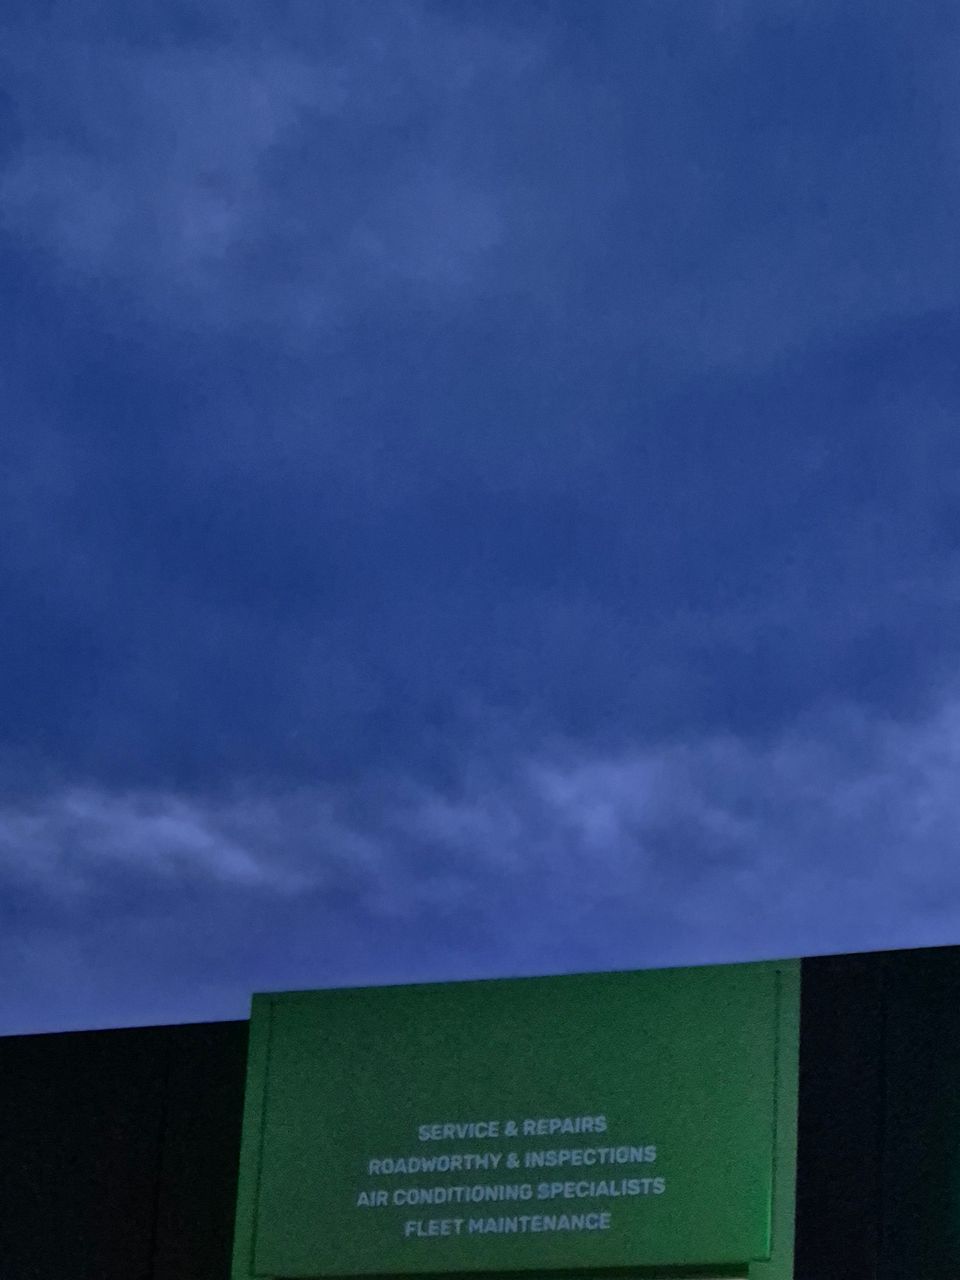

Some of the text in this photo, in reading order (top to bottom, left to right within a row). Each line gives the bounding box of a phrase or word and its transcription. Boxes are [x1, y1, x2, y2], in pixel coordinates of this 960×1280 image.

[418, 1116, 607, 1141] SERVICE & REPAIRS
[368, 1146, 657, 1175] ROADWORTHY & INSPECTIONS
[357, 1177, 666, 1207] AIR CONDITIONING SPECIALISTS
[405, 1213, 611, 1237] FLEET MAINTENANCE
